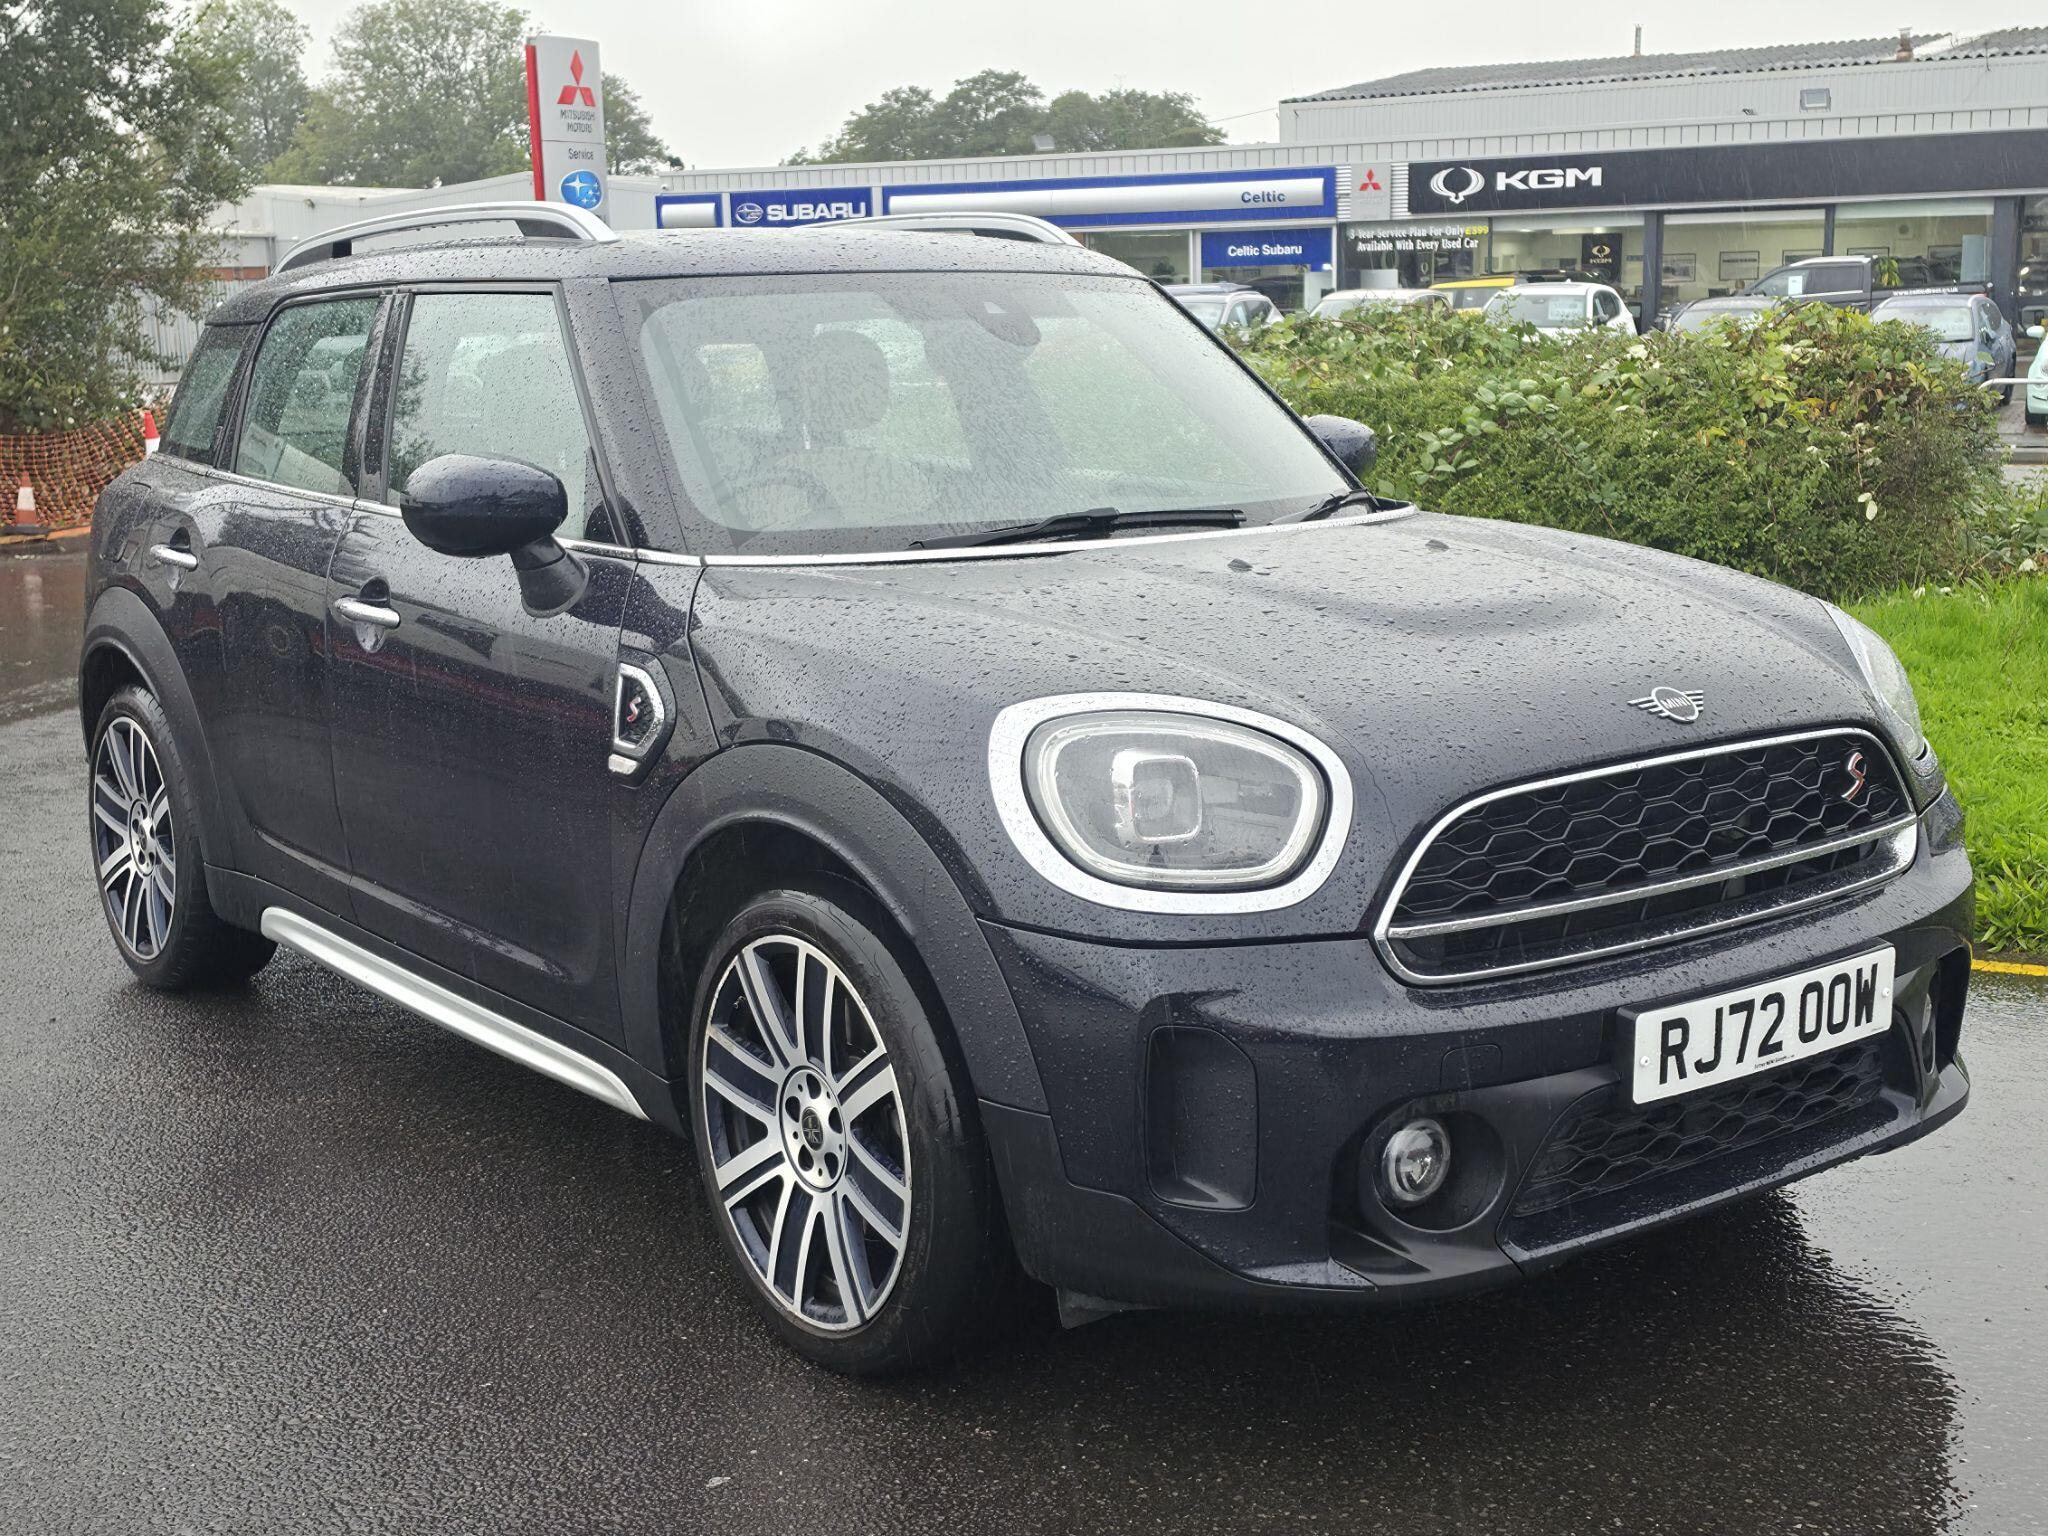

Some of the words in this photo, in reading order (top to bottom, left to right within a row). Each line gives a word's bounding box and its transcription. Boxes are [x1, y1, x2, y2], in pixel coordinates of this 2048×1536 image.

[567, 122, 593, 133] MOTORS
[568, 148, 594, 160] Service
[1496, 167, 1602, 191] KGM
[1241, 190, 1286, 203] Celtic
[766, 202, 866, 221] SUBARU
[1377, 226, 1407, 238] Service
[1409, 225, 1427, 237] Plan
[1429, 225, 1442, 236] For
[1445, 224, 1465, 238] Only
[1227, 244, 1260, 257] Celtic
[1262, 243, 1303, 255] Subaru
[1357, 239, 1394, 251] Available
[1396, 239, 1414, 250] With
[1416, 238, 1440, 251] Every
[1441, 237, 1462, 249] Used
[1464, 237, 1479, 248] Car
[1659, 992, 1785, 1085] RJ72
